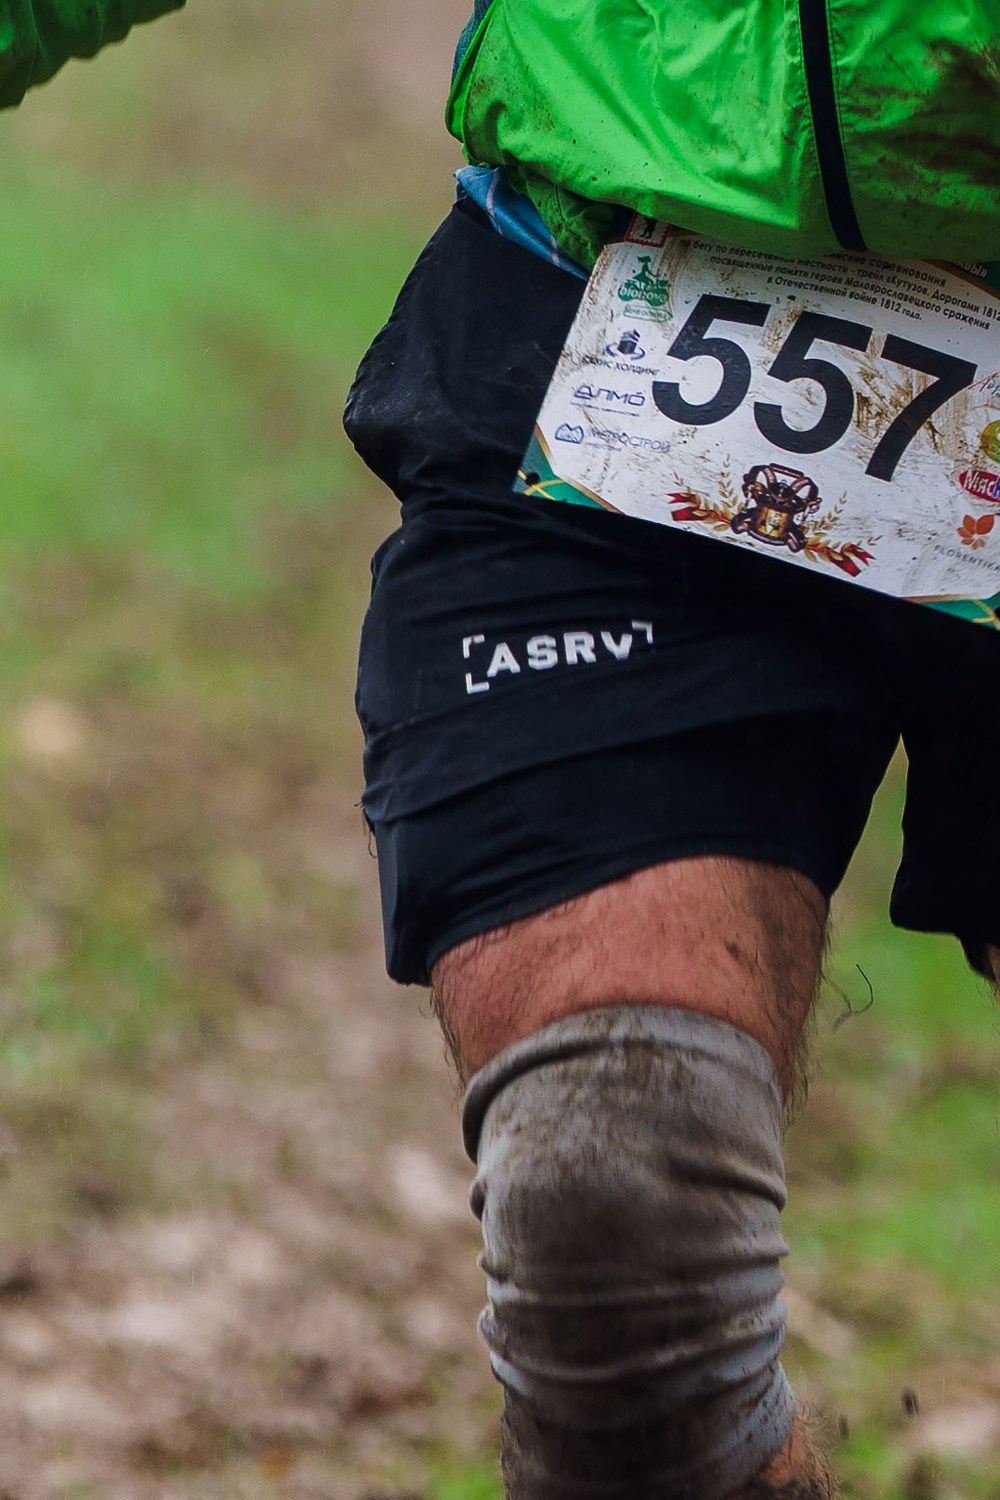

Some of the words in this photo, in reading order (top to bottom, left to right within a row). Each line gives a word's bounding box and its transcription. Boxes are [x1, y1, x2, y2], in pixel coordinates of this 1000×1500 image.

[715, 244, 728, 254] по
[857, 268, 885, 282] трейл
[932, 289, 980, 314] Дорогами
[774, 276, 848, 297] Отечественной
[848, 289, 878, 306] войне
[880, 298, 901, 313] 1812
[774, 266, 809, 279] памяти
[809, 271, 844, 287] героев
[844, 277, 942, 314] Малоярославецкого
[943, 306, 991, 331] сражения
[868, 259, 947, 287] соревнования
[651, 293, 978, 482] 557
[487, 631, 633, 677] ASRV
